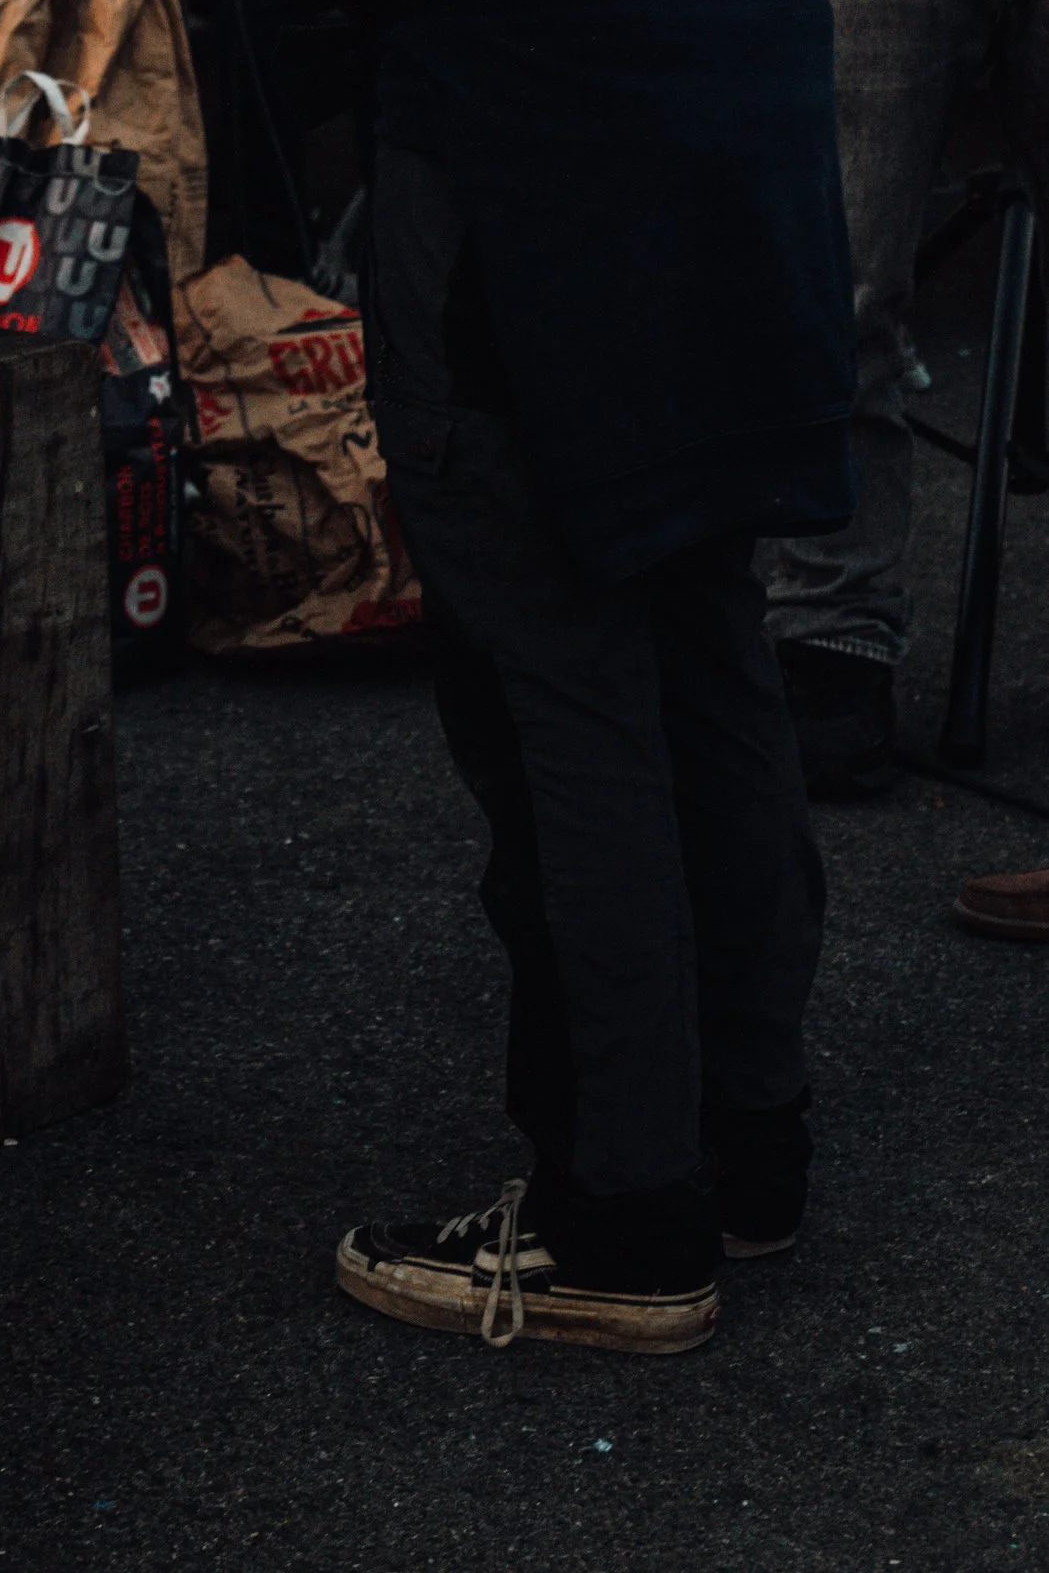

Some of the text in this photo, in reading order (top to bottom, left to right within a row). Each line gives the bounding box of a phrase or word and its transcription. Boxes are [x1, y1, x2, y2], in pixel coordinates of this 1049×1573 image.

[87, 220, 130, 262] U
[56, 256, 98, 297] U
[138, 580, 160, 613] U
